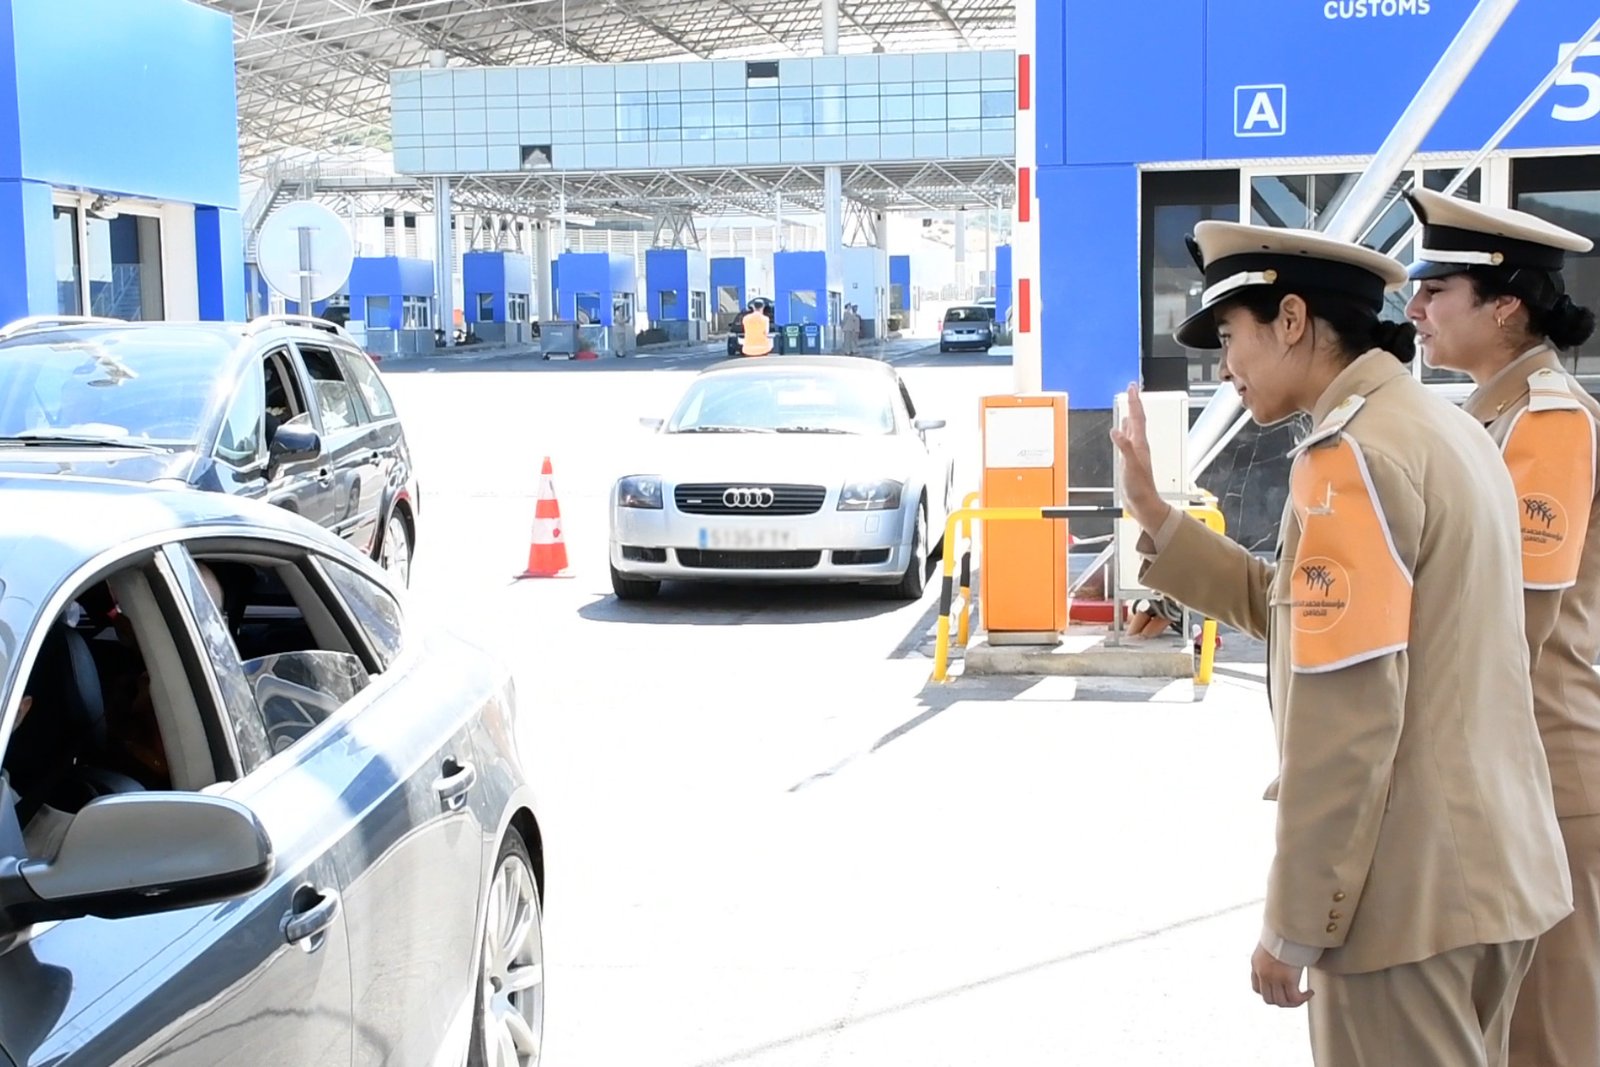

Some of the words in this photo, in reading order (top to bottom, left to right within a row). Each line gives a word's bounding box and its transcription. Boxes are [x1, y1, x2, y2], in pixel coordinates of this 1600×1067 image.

[1324, 0, 1430, 19] CUSTOMS
[1551, 41, 1600, 121] 5
[1243, 92, 1279, 129] A
